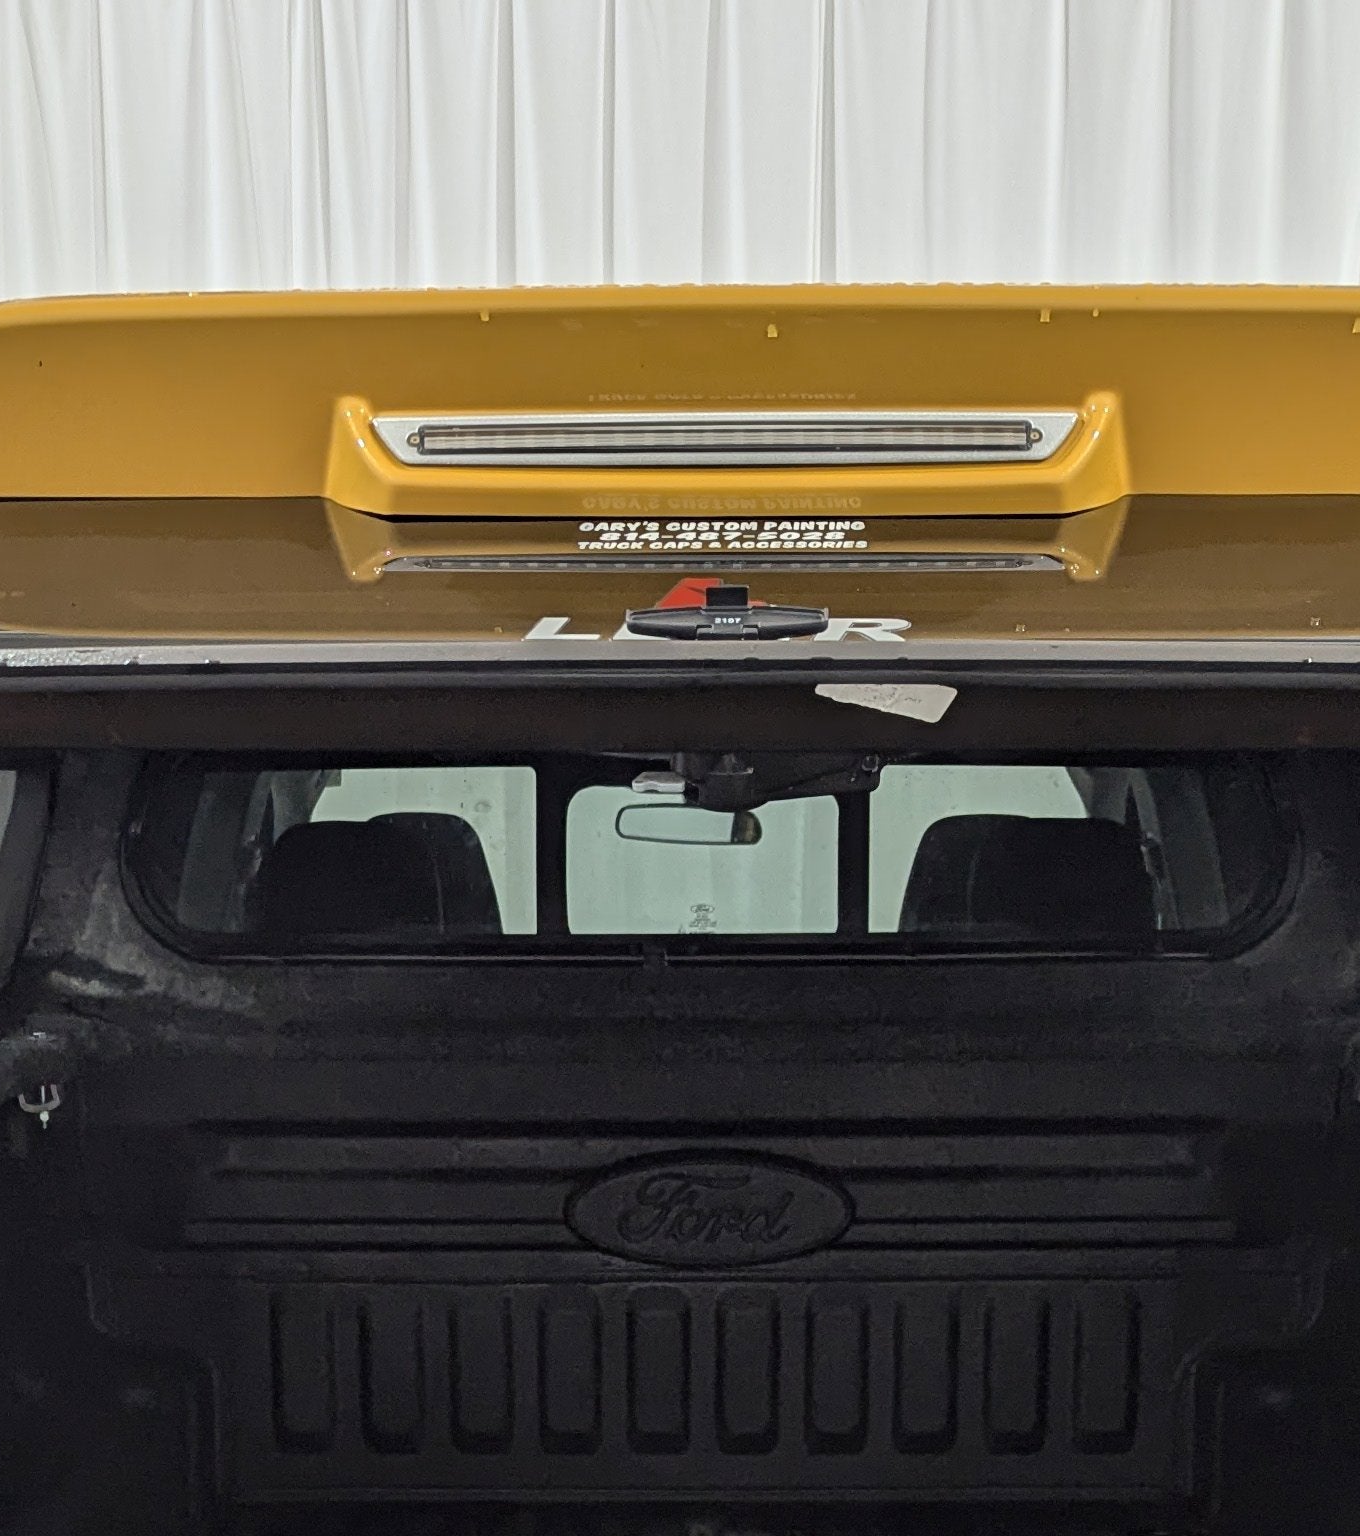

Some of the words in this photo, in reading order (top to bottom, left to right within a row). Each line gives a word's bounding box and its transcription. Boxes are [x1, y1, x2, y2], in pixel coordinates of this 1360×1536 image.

[578, 520, 660, 532] GARY'S
[665, 521, 758, 531] CUSTOM
[763, 520, 866, 531] PAINTING
[577, 541, 645, 550] TRUCK
[649, 541, 704, 550] CAPS
[727, 540, 869, 549] ACCESSORIES
[524, 616, 912, 642] LR
[616, 1171, 797, 1245] Ford
